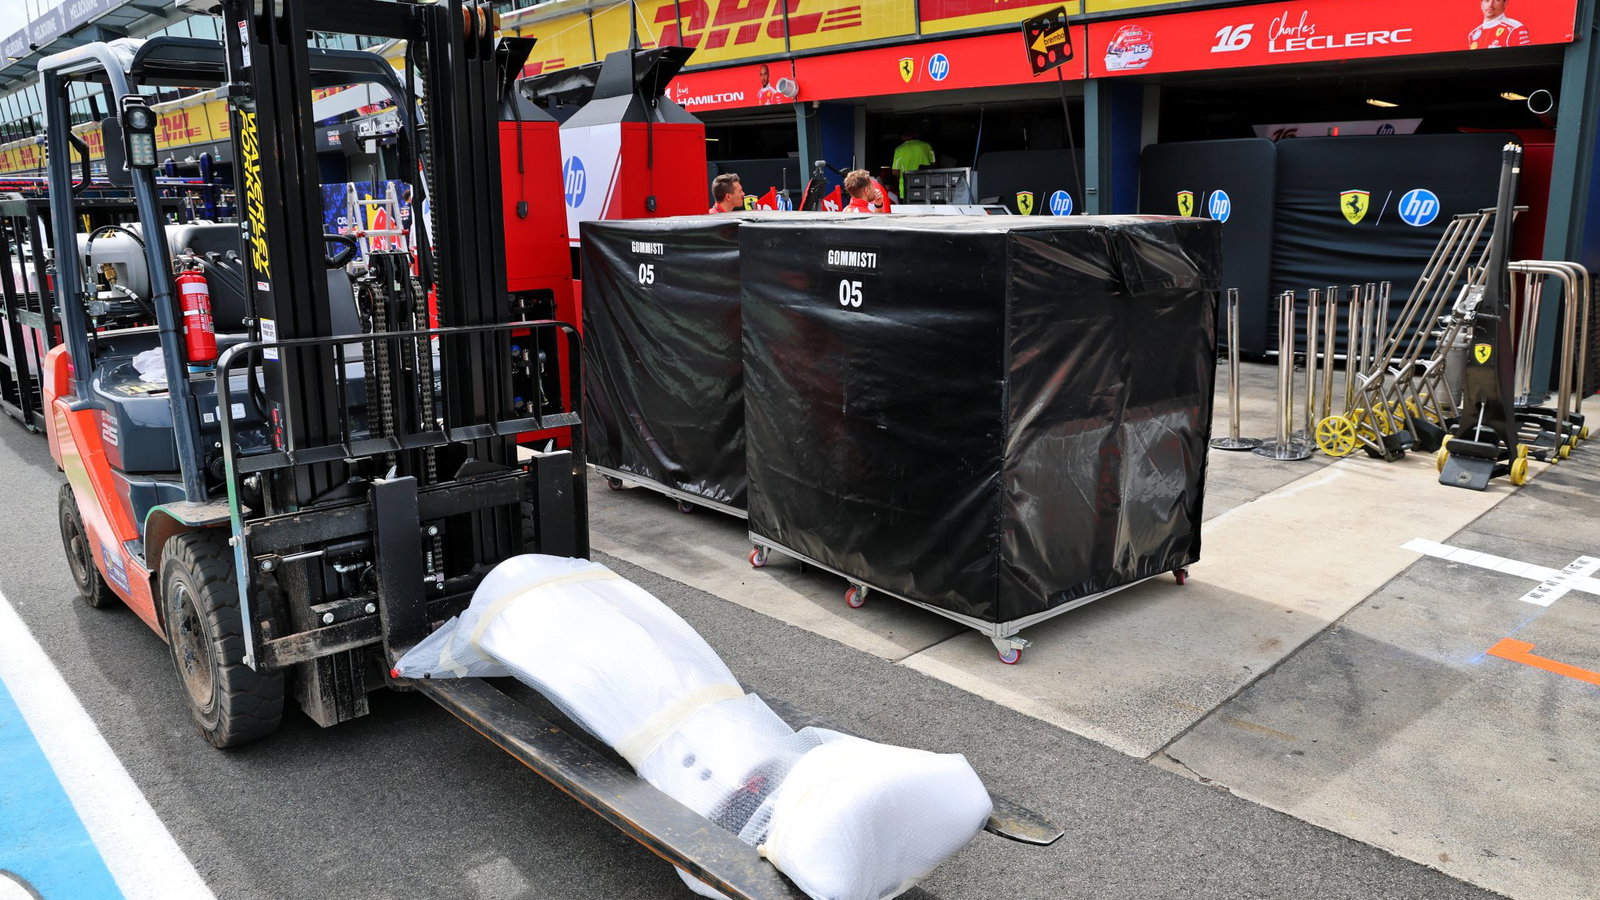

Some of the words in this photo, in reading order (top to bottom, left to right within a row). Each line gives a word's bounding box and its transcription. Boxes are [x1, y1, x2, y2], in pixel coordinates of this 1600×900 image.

[69, 0, 98, 21] MELBOURNE
[654, 0, 824, 49] DHL
[1043, 31, 1065, 46] brembo
[1211, 24, 1254, 53] 16
[1268, 10, 1315, 41] Charles
[1131, 44, 1150, 55] 16
[1268, 28, 1413, 53] LECLERC
[930, 54, 948, 81] hp
[677, 91, 744, 106] HAMILTON
[159, 112, 194, 142] DHL
[239, 109, 263, 273] FORKLIFTS
[247, 112, 271, 279] WAVERLEY
[564, 156, 585, 208] hp
[1052, 191, 1070, 216] hp
[1210, 190, 1229, 223] hp
[1400, 189, 1438, 227] hp
[631, 241, 664, 255] GOMMISTI
[828, 250, 877, 268] GOMMISTI
[638, 263, 655, 285] 05
[839, 279, 863, 308] 05
